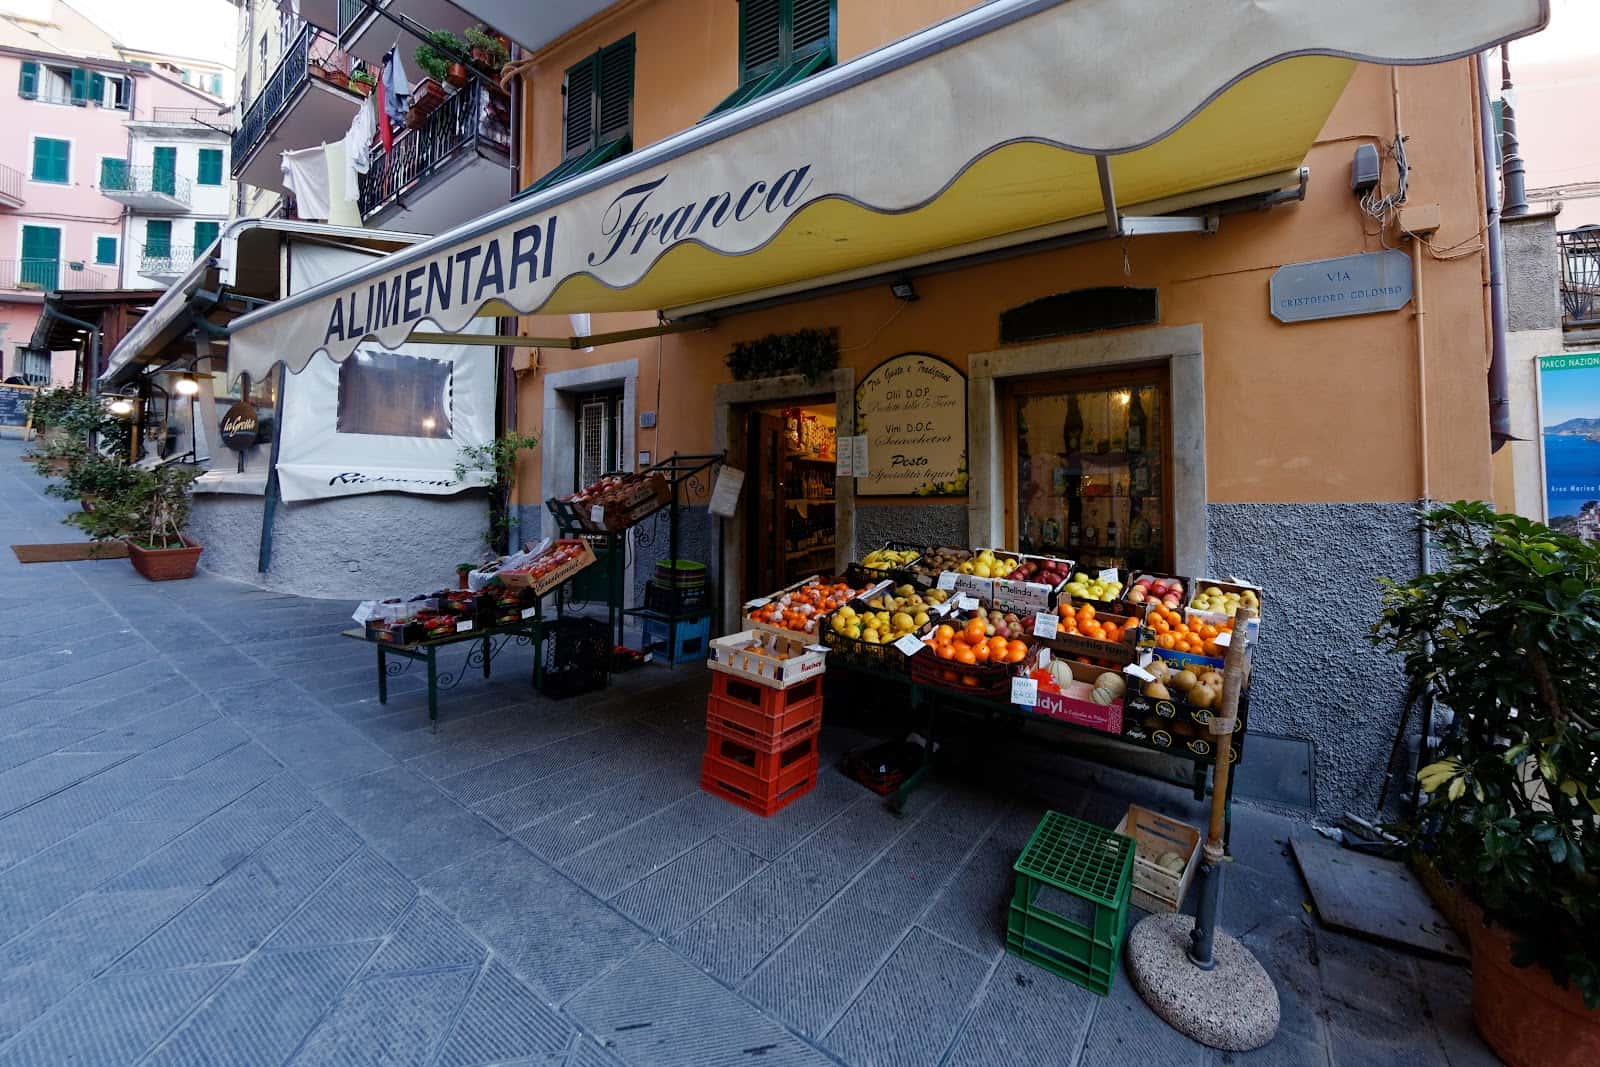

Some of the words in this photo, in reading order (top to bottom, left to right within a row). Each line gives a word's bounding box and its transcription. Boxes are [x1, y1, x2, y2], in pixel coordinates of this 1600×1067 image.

[323, 215, 558, 346] ALIMENTARI
[587, 163, 814, 268] Franca
[1326, 271, 1352, 283] VIA
[1281, 293, 1345, 308] CRISTOFORO
[1350, 285, 1403, 300] COLOMBO
[1541, 359, 1566, 369] PARCO
[885, 423, 902, 434] Vini
[891, 454, 929, 468] Pesto
[1000, 585, 1032, 597] Melinda
[1000, 604, 1032, 616] Melinda
